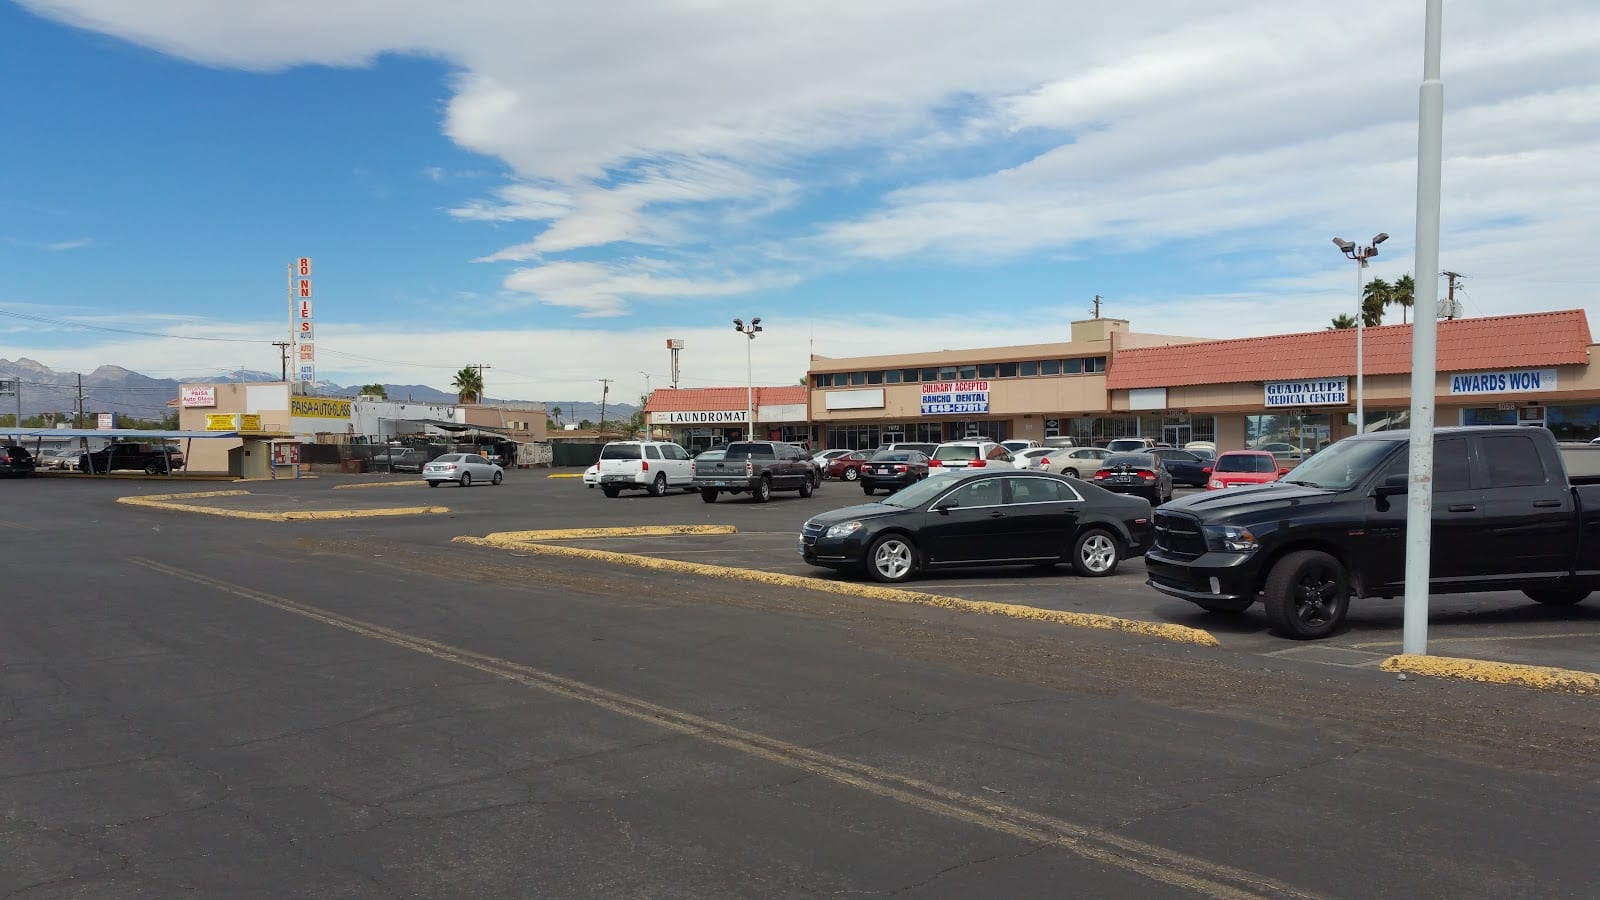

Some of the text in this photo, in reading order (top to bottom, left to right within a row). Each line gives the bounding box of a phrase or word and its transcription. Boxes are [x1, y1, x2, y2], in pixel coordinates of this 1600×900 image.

[922, 381, 988, 393] CULINARY ACCEPTED
[1267, 381, 1345, 395] GUADALUPE
[1453, 371, 1540, 393] AWARDS WON
[922, 393, 986, 404] RANCHO DENTAL
[1267, 392, 1345, 405] MEDICAL CENTER
[670, 411, 747, 422] LAUNDROMAT
